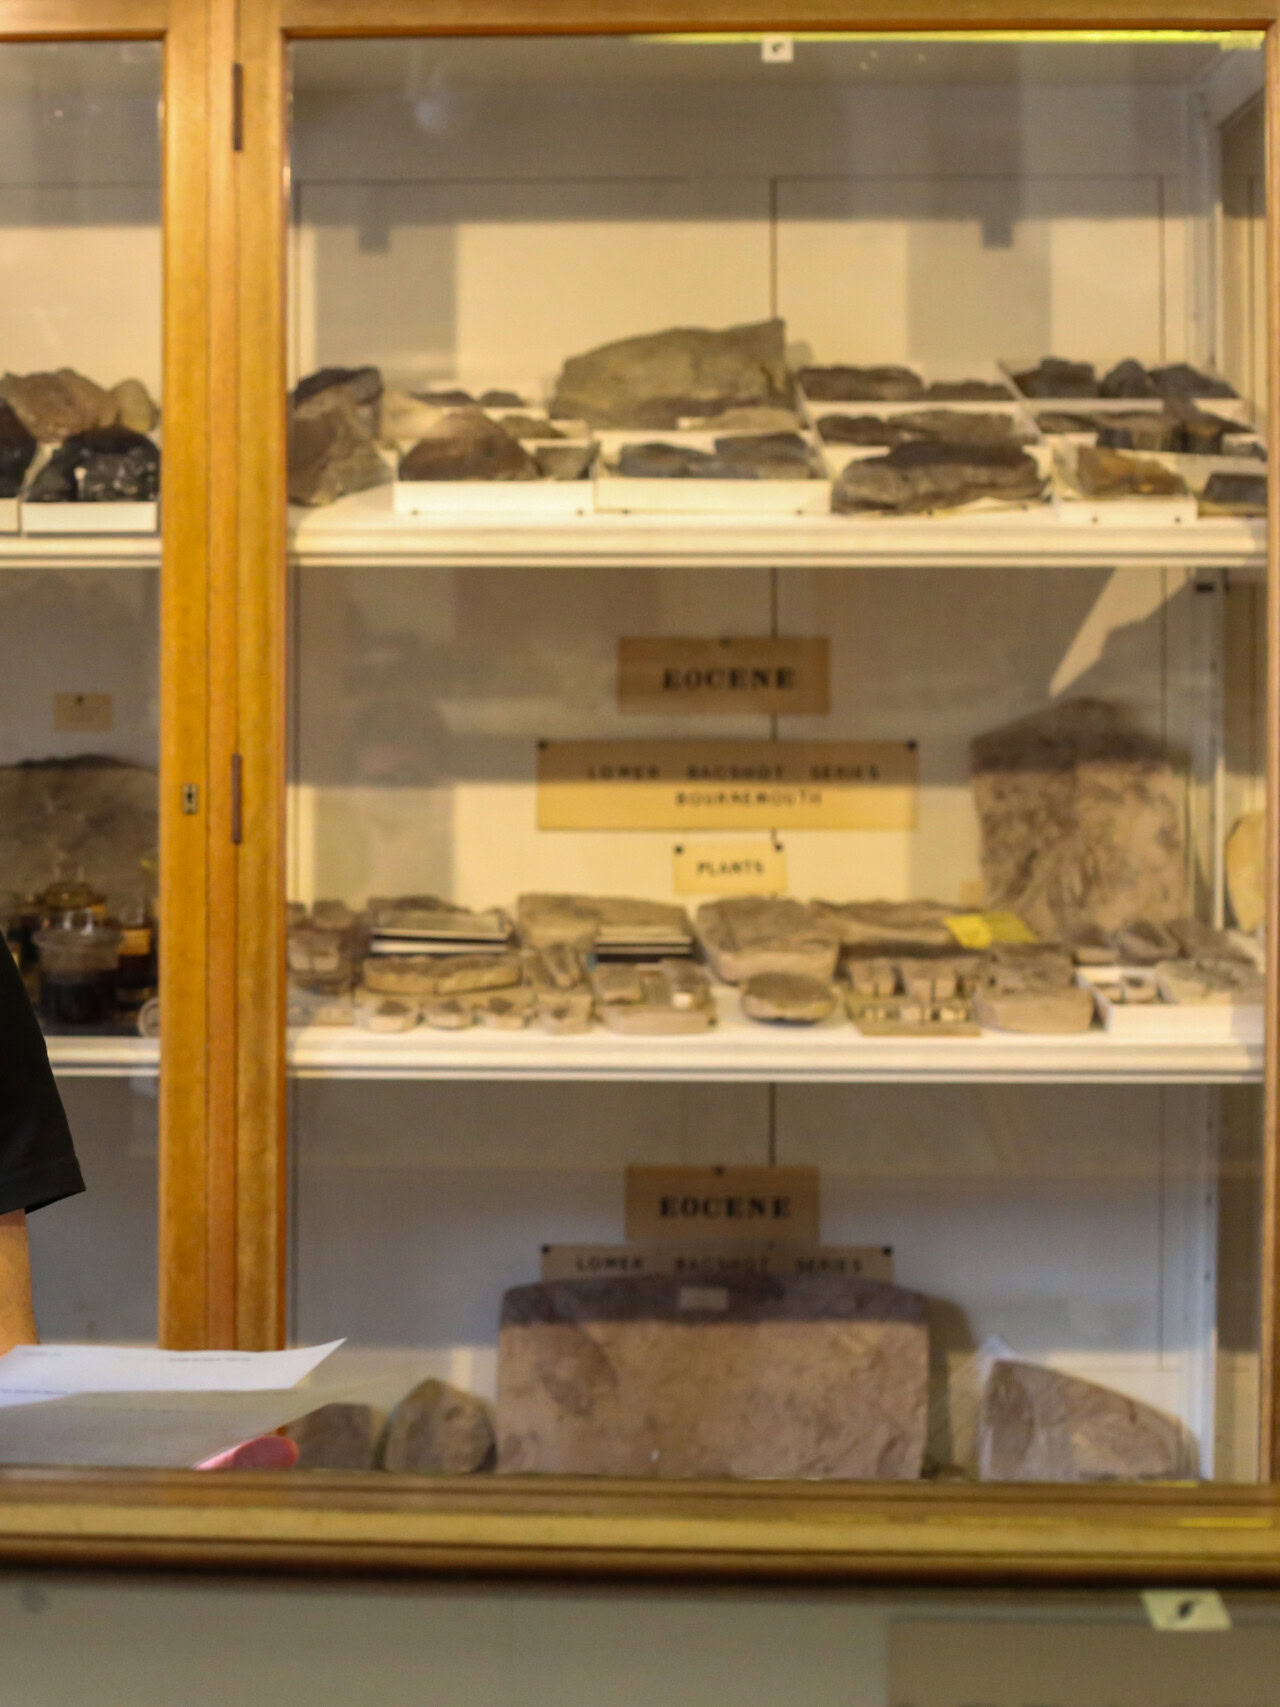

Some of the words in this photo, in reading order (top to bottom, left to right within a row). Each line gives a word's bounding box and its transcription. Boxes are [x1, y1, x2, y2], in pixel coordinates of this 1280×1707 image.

[662, 667, 796, 691] EOCENE
[587, 765, 660, 780] LOWER
[810, 764, 880, 781] SERIES
[697, 860, 765, 876] PLANTS
[659, 1195, 793, 1219] EOCENE
[575, 1256, 645, 1272] LOWER
